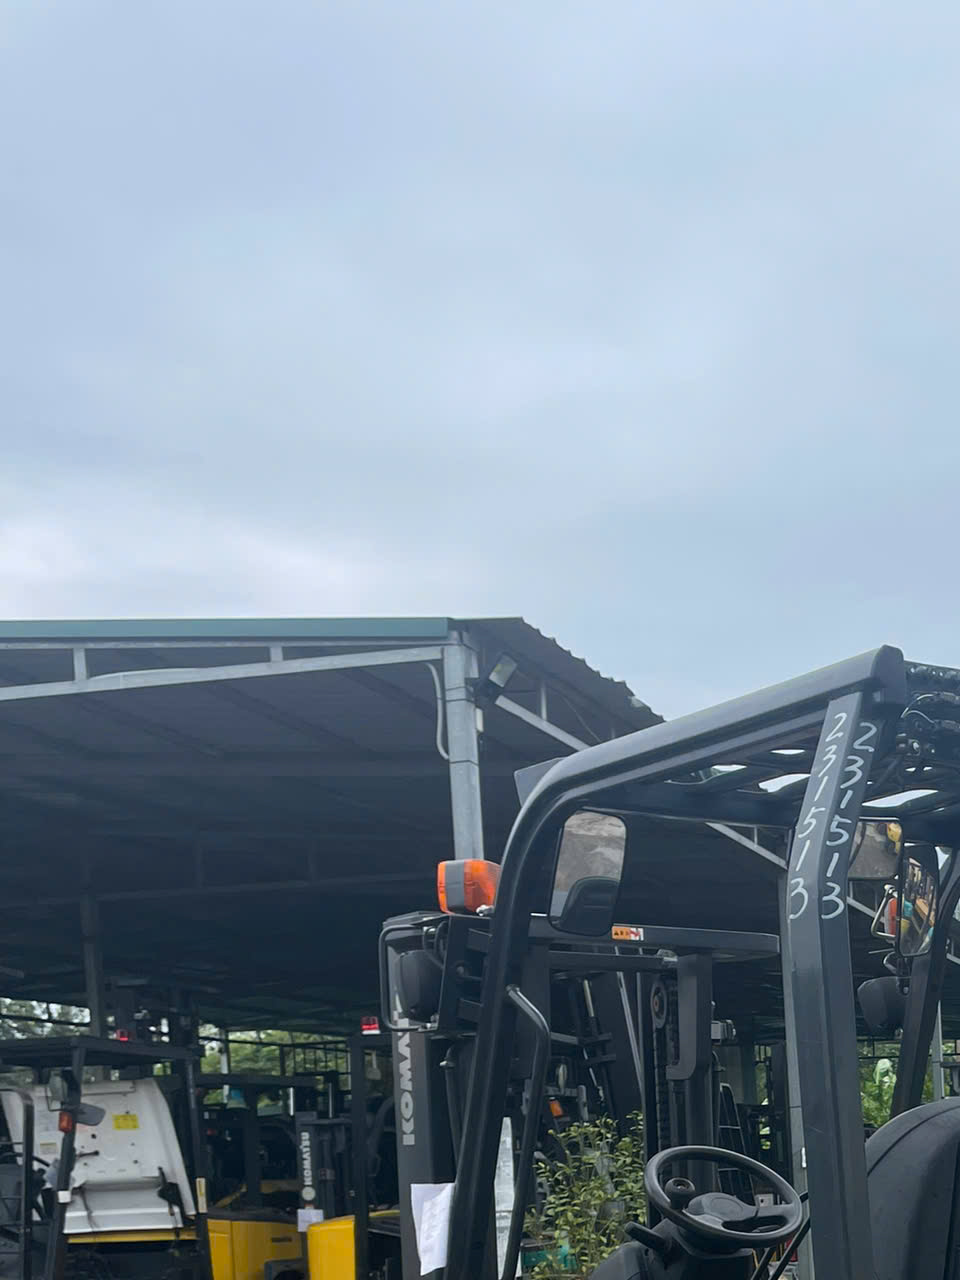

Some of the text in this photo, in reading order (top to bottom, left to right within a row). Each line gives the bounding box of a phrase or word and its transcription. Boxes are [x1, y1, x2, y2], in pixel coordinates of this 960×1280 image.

[788, 711, 848, 920] 231513
[820, 721, 878, 920] 231513
[299, 1131, 313, 1186] KOMATSU
[393, 1010, 415, 1146] KOMAT
